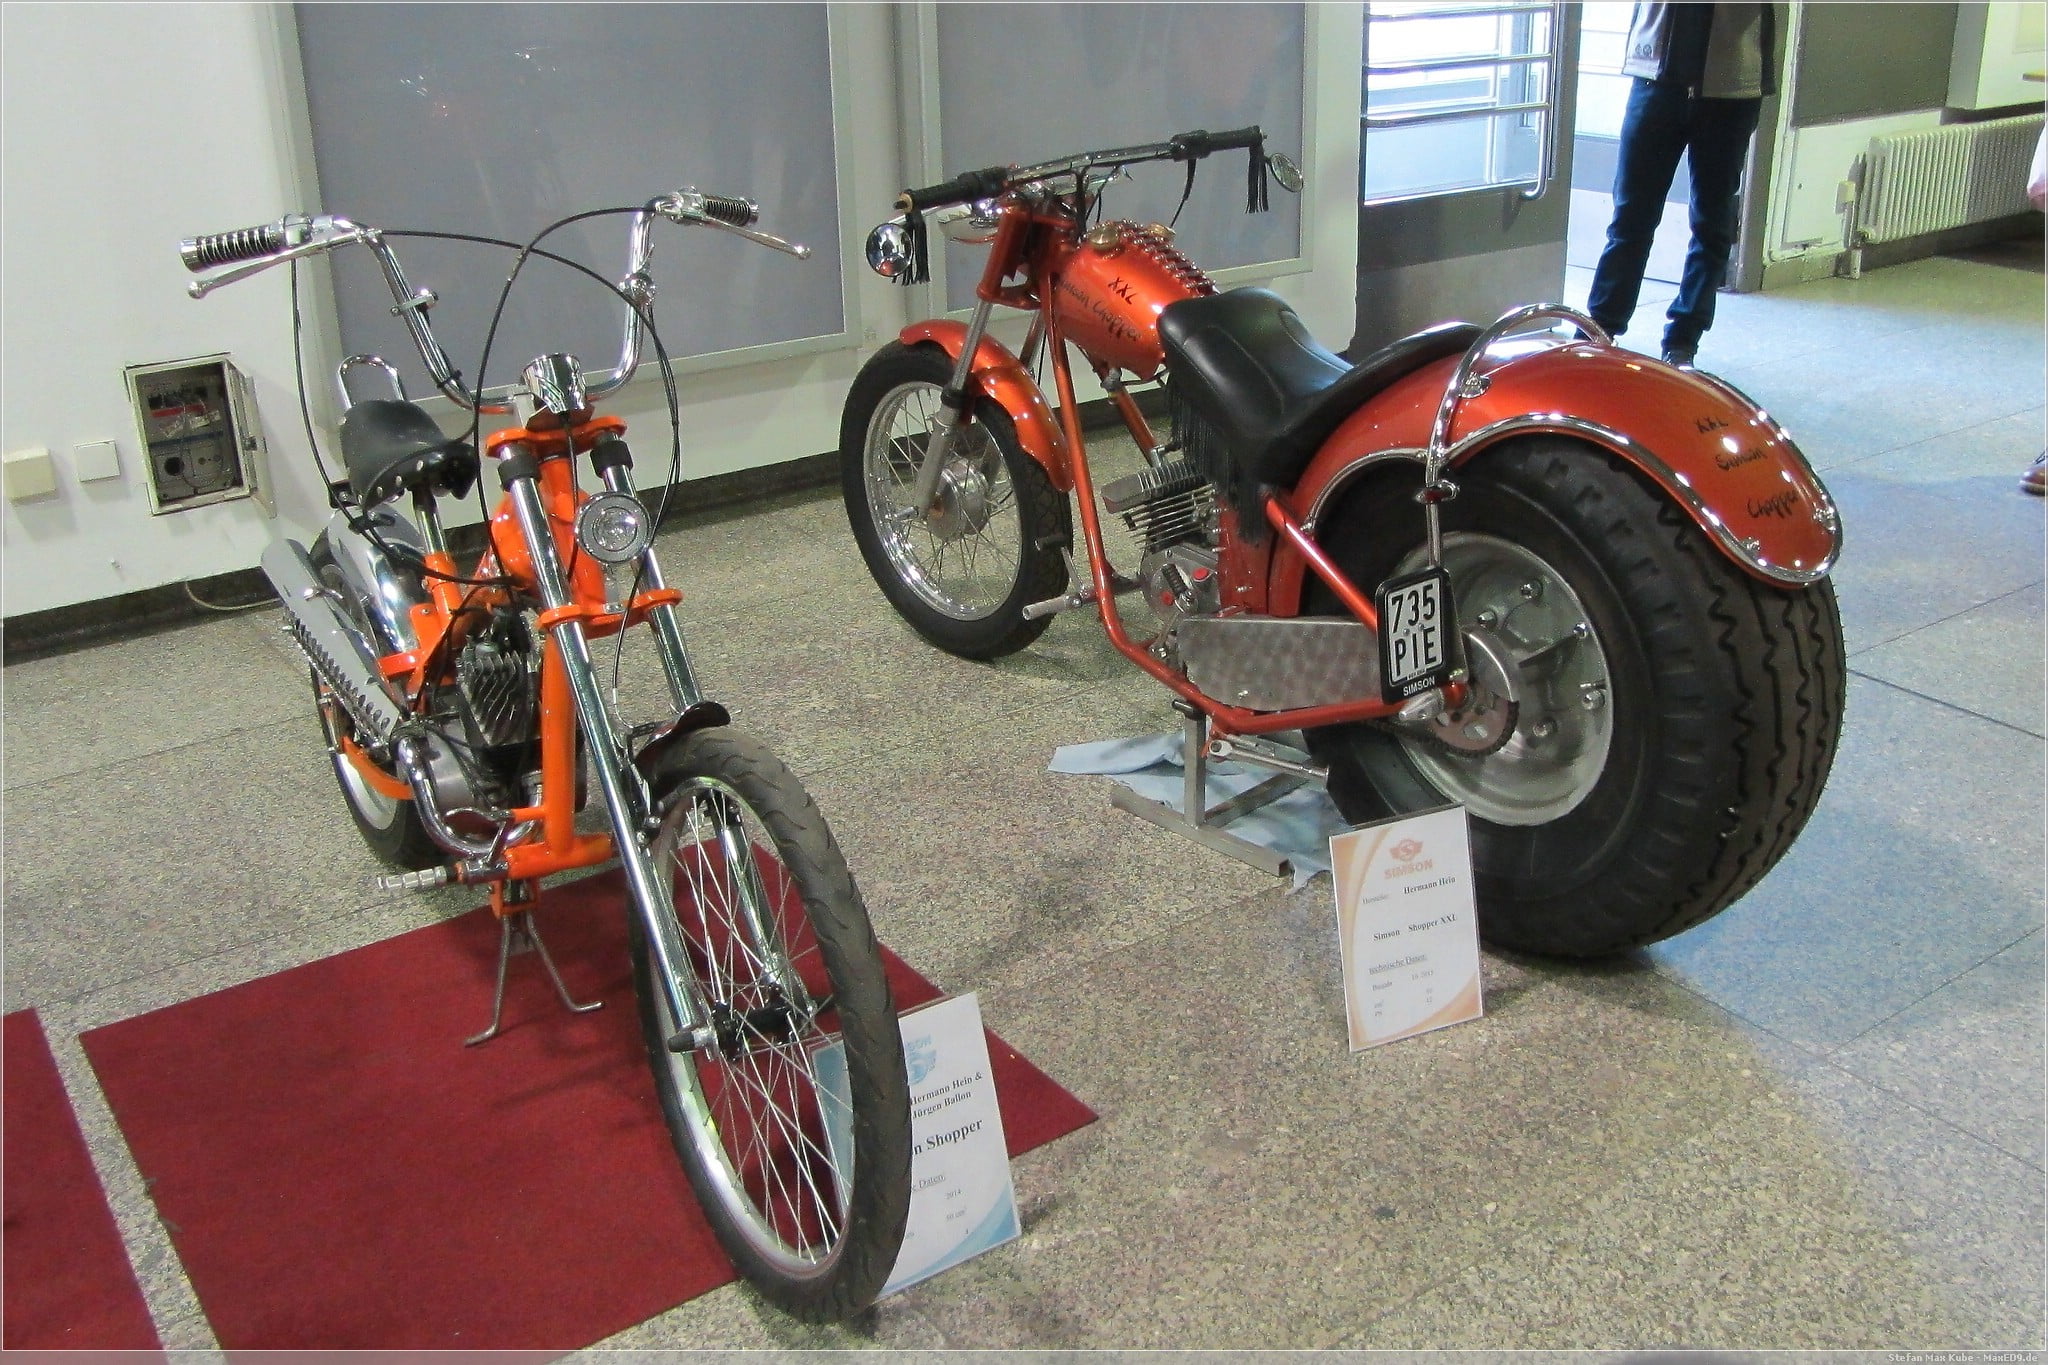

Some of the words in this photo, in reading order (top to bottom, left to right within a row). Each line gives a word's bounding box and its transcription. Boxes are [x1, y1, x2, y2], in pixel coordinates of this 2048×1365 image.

[1108, 276, 1138, 306] XXL
[1391, 583, 1436, 634] 735
[1394, 626, 1437, 677] PIE
[1403, 675, 1435, 697] SIMSON
[1384, 859, 1433, 880] SIMSON
[1403, 881, 1438, 895] Hermann
[1438, 876, 1457, 886] Hein
[1373, 929, 1401, 942] Simson
[1408, 918, 1439, 933] Shopper
[952, 1075, 973, 1090] Hein
[975, 1071, 983, 1081] &
[912, 1102, 942, 1120] Jürgen
[944, 1091, 972, 1107] Ballon
[926, 1119, 983, 1150] Shopper
